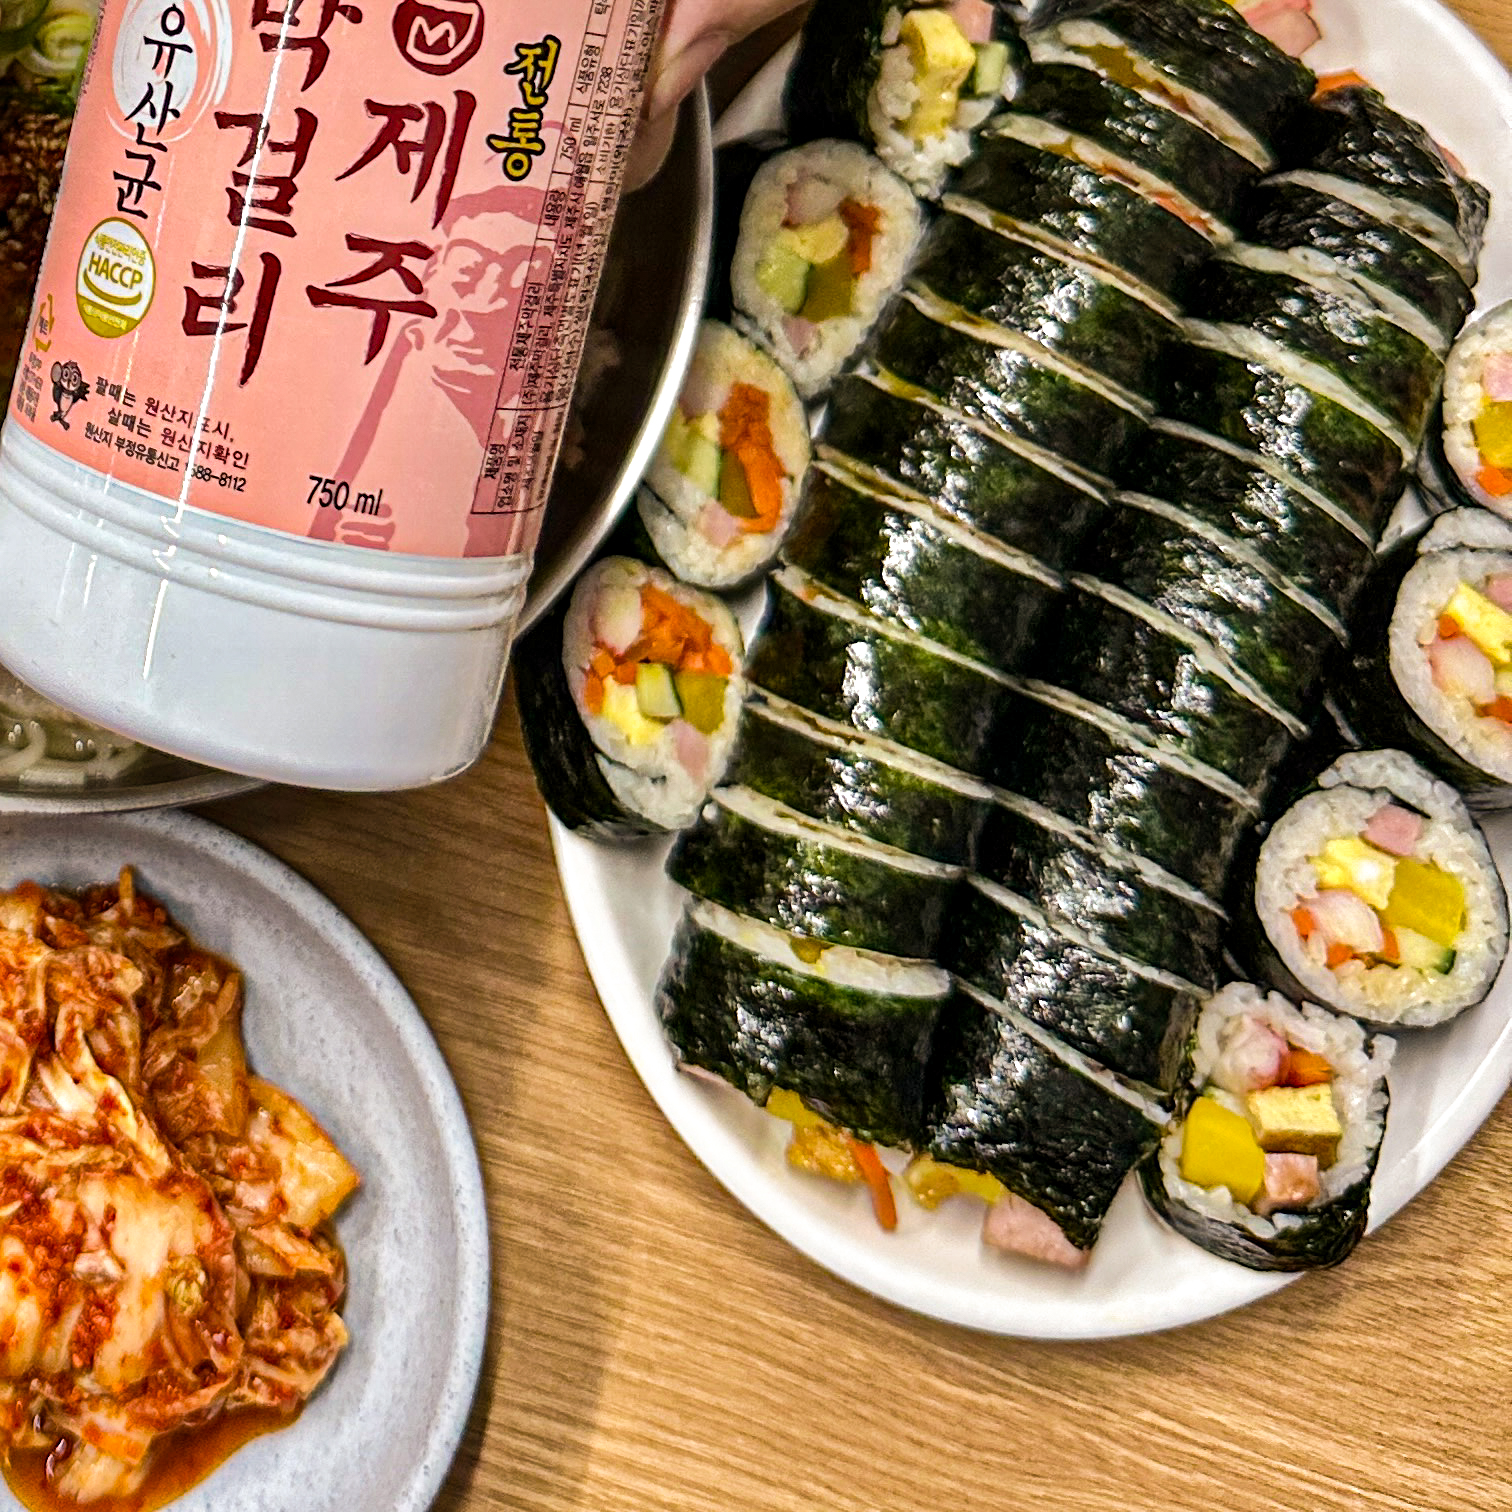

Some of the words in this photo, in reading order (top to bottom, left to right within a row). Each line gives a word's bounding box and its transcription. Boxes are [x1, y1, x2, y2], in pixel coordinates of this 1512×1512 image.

[573, 42, 602, 96] 식품유형
[595, 64, 614, 95] 7238
[486, 35, 561, 181] 전통
[565, 115, 582, 133] ml
[558, 133, 578, 161] 750
[306, 89, 475, 365] 제주
[88, 253, 144, 290] HACCP
[107, 407, 152, 439] 살때는
[160, 427, 250, 470] 원산지확인
[305, 475, 351, 510] 750
[354, 487, 385, 516] ml
